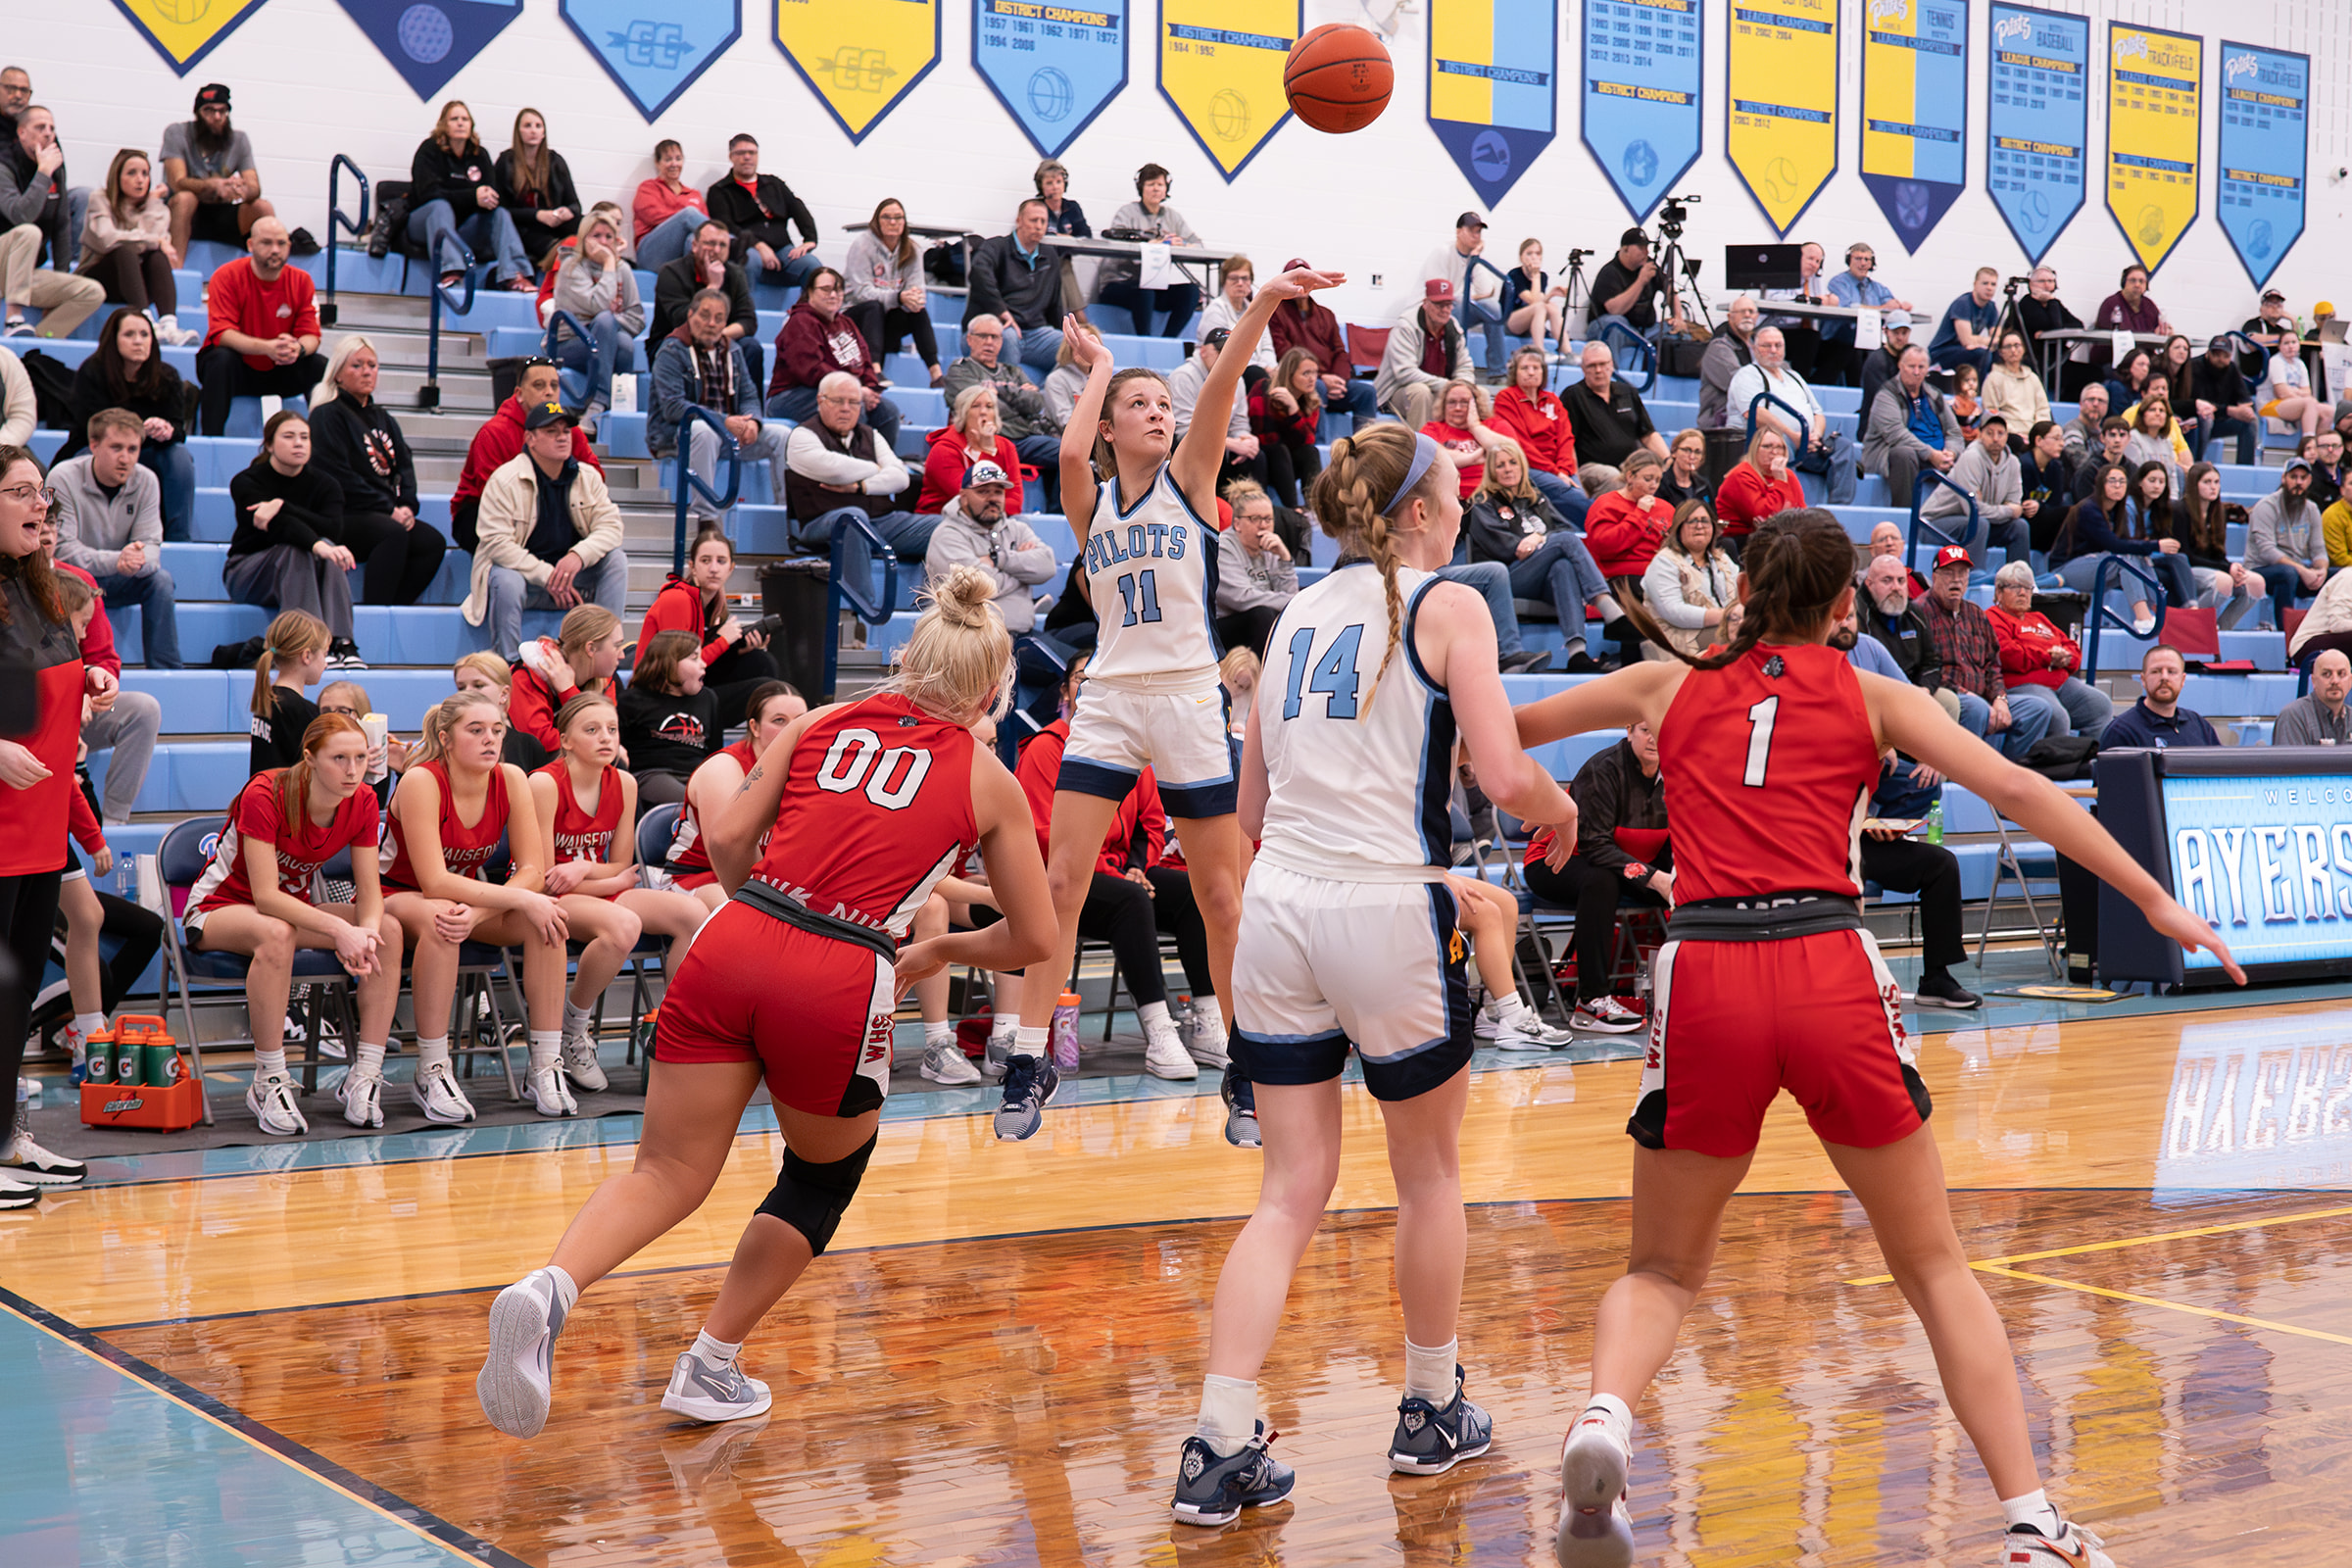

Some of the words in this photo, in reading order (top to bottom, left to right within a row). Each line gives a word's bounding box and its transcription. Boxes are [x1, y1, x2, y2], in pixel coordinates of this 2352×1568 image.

[994, 0, 1045, 19] DISTRICT
[1045, 6, 1108, 27] CHAMPIONS
[1741, 9, 1775, 25] LEAGUE
[1776, 15, 1826, 33] CHAMPIONS
[1927, 10, 1954, 29] TENNIS
[984, 17, 1006, 29] 1957
[1012, 20, 1034, 33] 1961
[1041, 24, 1062, 37] 1962
[1068, 26, 1090, 41] 1971
[1096, 30, 1118, 45] 1972
[984, 34, 1006, 48] 1994
[1177, 24, 1224, 43] DISTRICT
[1225, 30, 1284, 50] CHAMPIONS
[1993, 14, 2032, 47] Pilots
[2036, 30, 2075, 52] BASEBALL
[2114, 32, 2148, 67] Pilots
[1445, 61, 1486, 77] DISTRICT
[1487, 67, 1540, 84] CHAMPIONS
[2032, 57, 2076, 73] CHAMPIONS
[2225, 52, 2258, 84] Pilots
[1598, 81, 1637, 98] DISTRICT
[1637, 86, 1687, 104] CHAMPIONS
[1740, 100, 1777, 116] DISTRICT
[1778, 105, 1824, 122] CHAMPIONS
[2000, 137, 2032, 152] DISTRICT
[2033, 142, 2073, 157] CHAMPIONS
[1441, 282, 1450, 294] P
[545, 403, 564, 415] M
[1088, 523, 1187, 575] PILOTS
[1945, 548, 1964, 560] W
[1117, 569, 1162, 628] 11
[1283, 623, 1364, 721] 14
[1742, 695, 1780, 788] 1
[815, 728, 934, 811] 00
[2265, 788, 2352, 805] WELCO
[2176, 824, 2352, 927] AYERS
[864, 1014, 891, 1064] WHS
[88, 1056, 105, 1076] G
[119, 1057, 132, 1078] G
